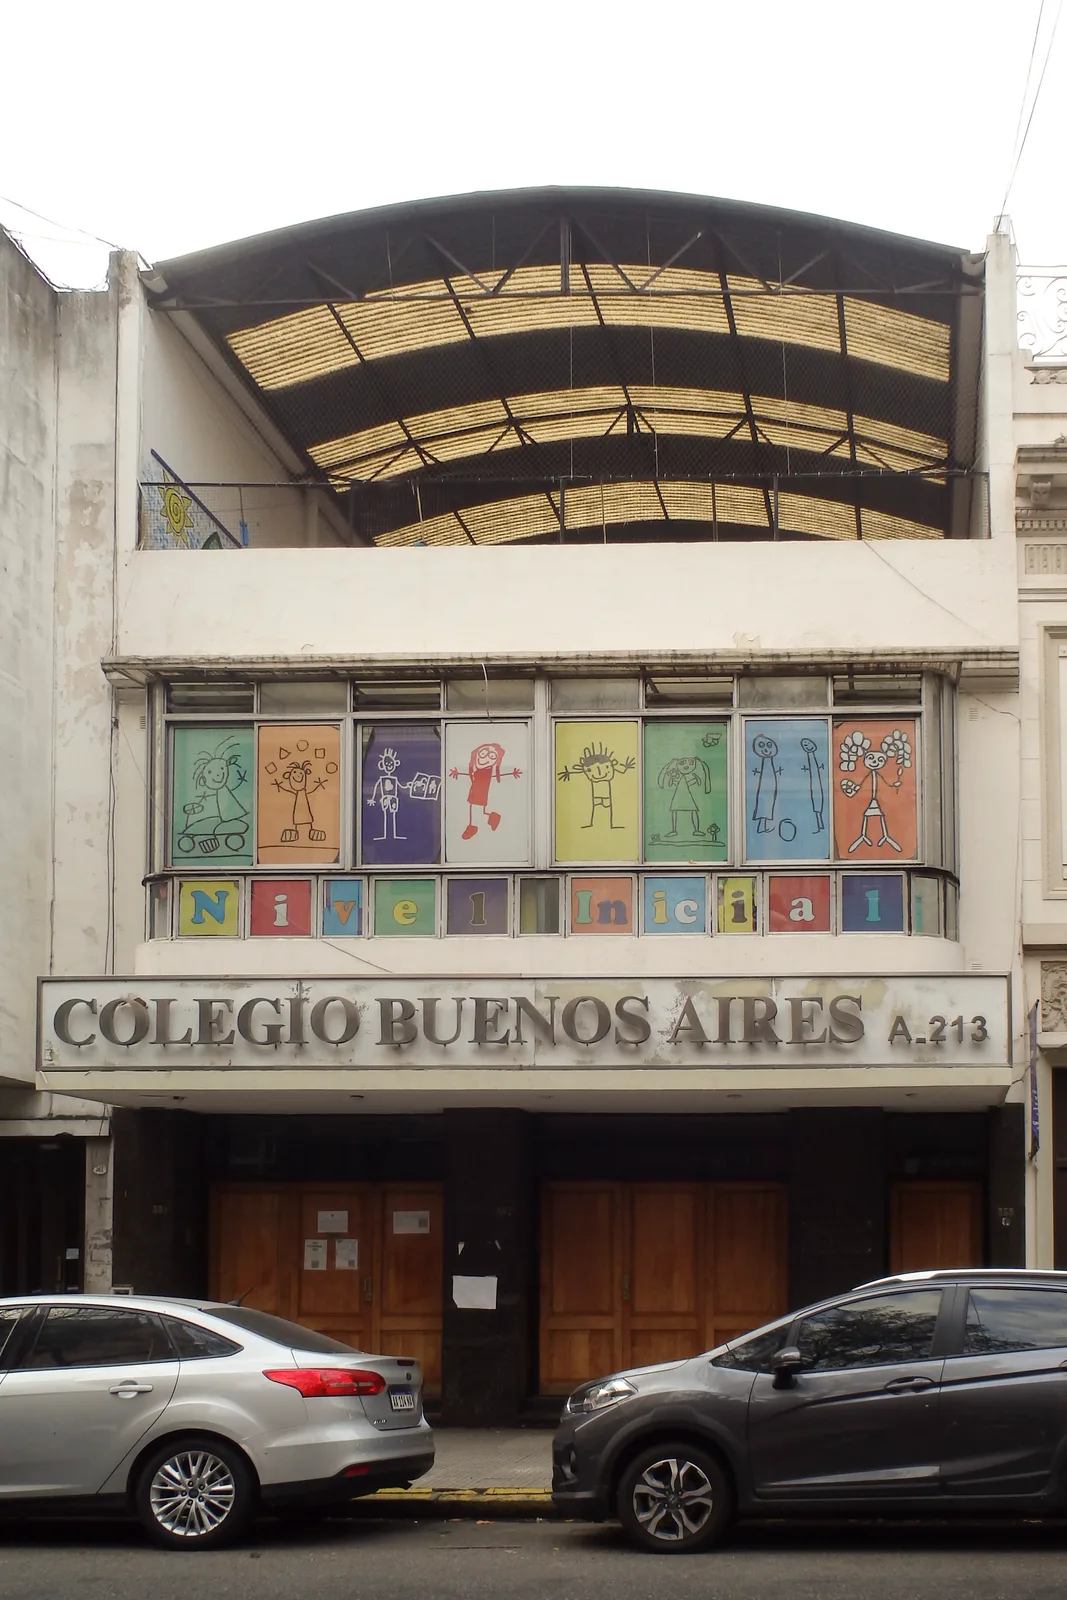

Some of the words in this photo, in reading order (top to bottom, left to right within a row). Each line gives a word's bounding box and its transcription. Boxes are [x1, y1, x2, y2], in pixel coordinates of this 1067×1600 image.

[190, 889, 486, 927] Nivel
[574, 889, 882, 925] Inicial
[53, 996, 360, 1046] COLEGIO
[374, 996, 651, 1046] BUENOS
[666, 995, 864, 1045] AIRES
